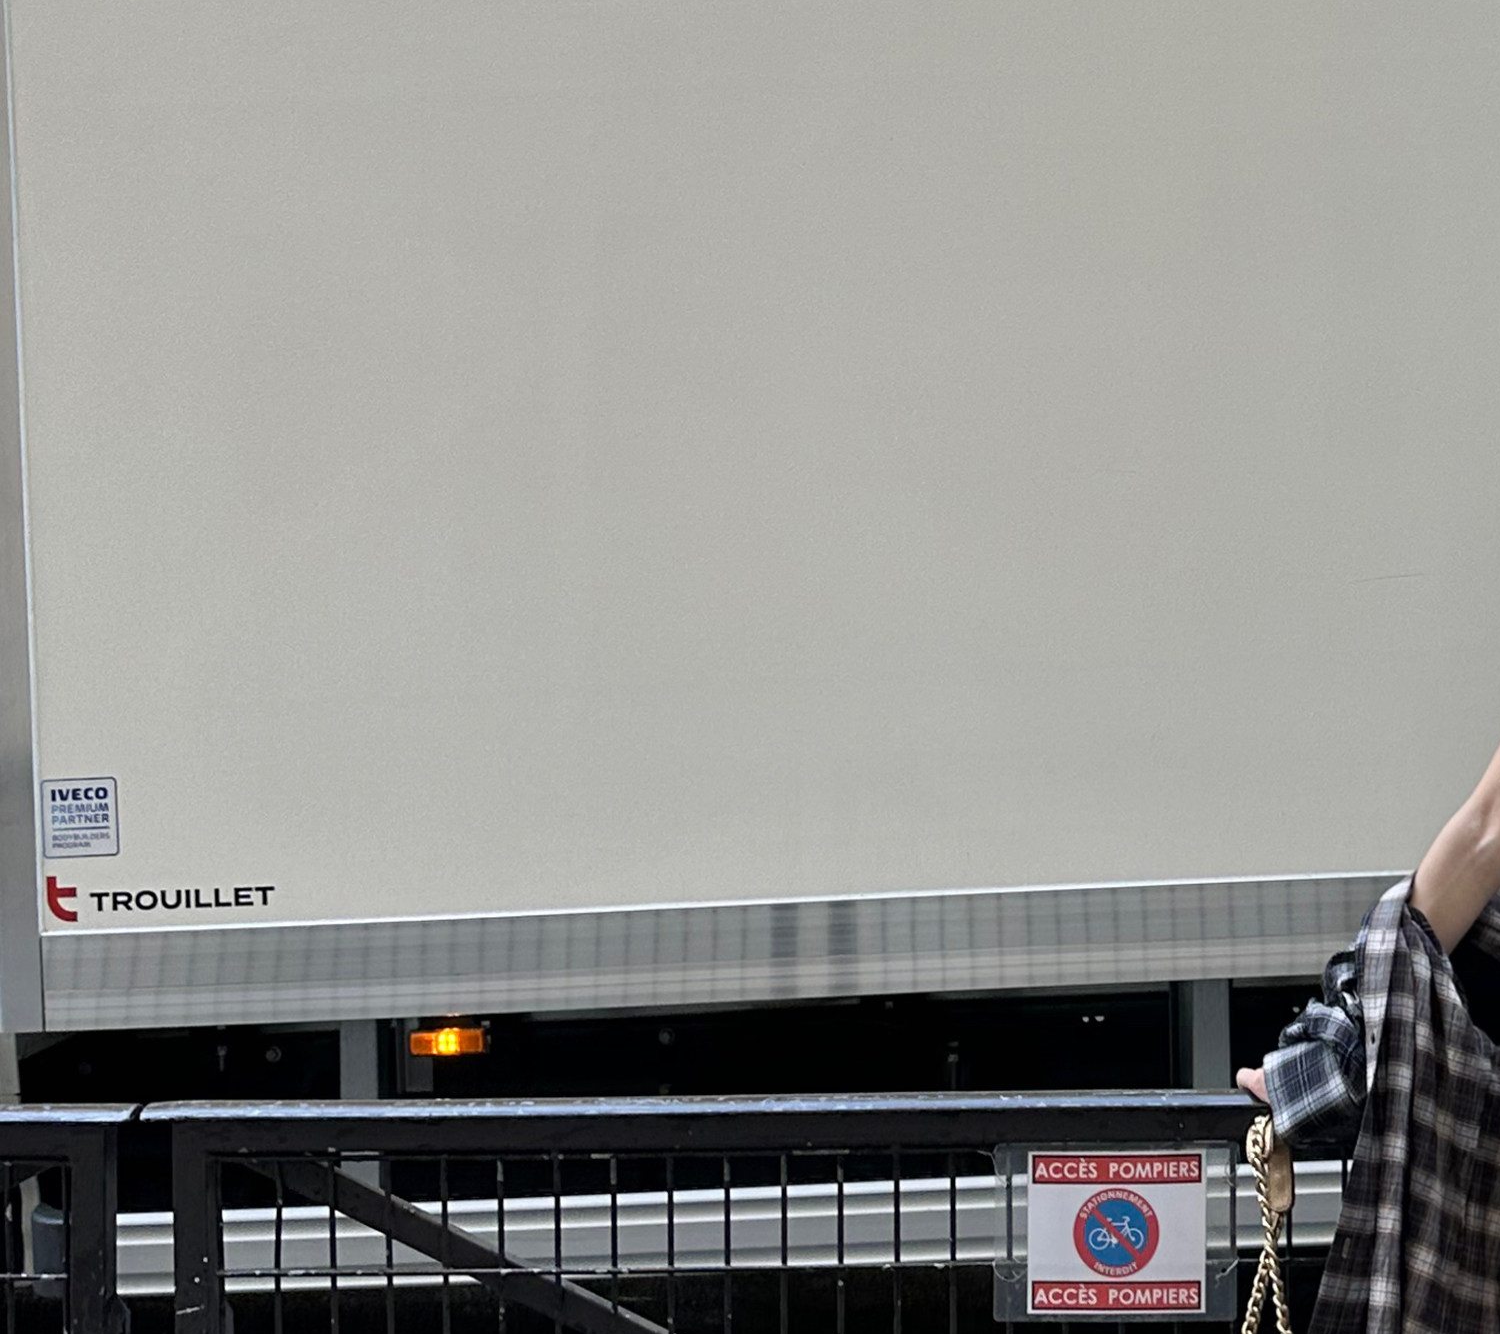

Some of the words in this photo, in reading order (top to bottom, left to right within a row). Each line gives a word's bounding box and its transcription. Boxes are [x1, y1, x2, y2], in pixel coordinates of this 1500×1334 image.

[51, 787, 108, 802] IVECO
[51, 803, 109, 814] PREMIUM
[52, 813, 109, 825] PARTNER
[90, 886, 275, 912] TROUILLET
[1034, 1157, 1098, 1179] ACCÈS
[1109, 1160, 1199, 1178] POMPIERS
[1079, 1191, 1153, 1219] STATIONNEMENT
[1094, 1262, 1138, 1276] INTERDIT
[1034, 1284, 1098, 1305] ACCÈS
[1108, 1286, 1199, 1305] POMPIERS
